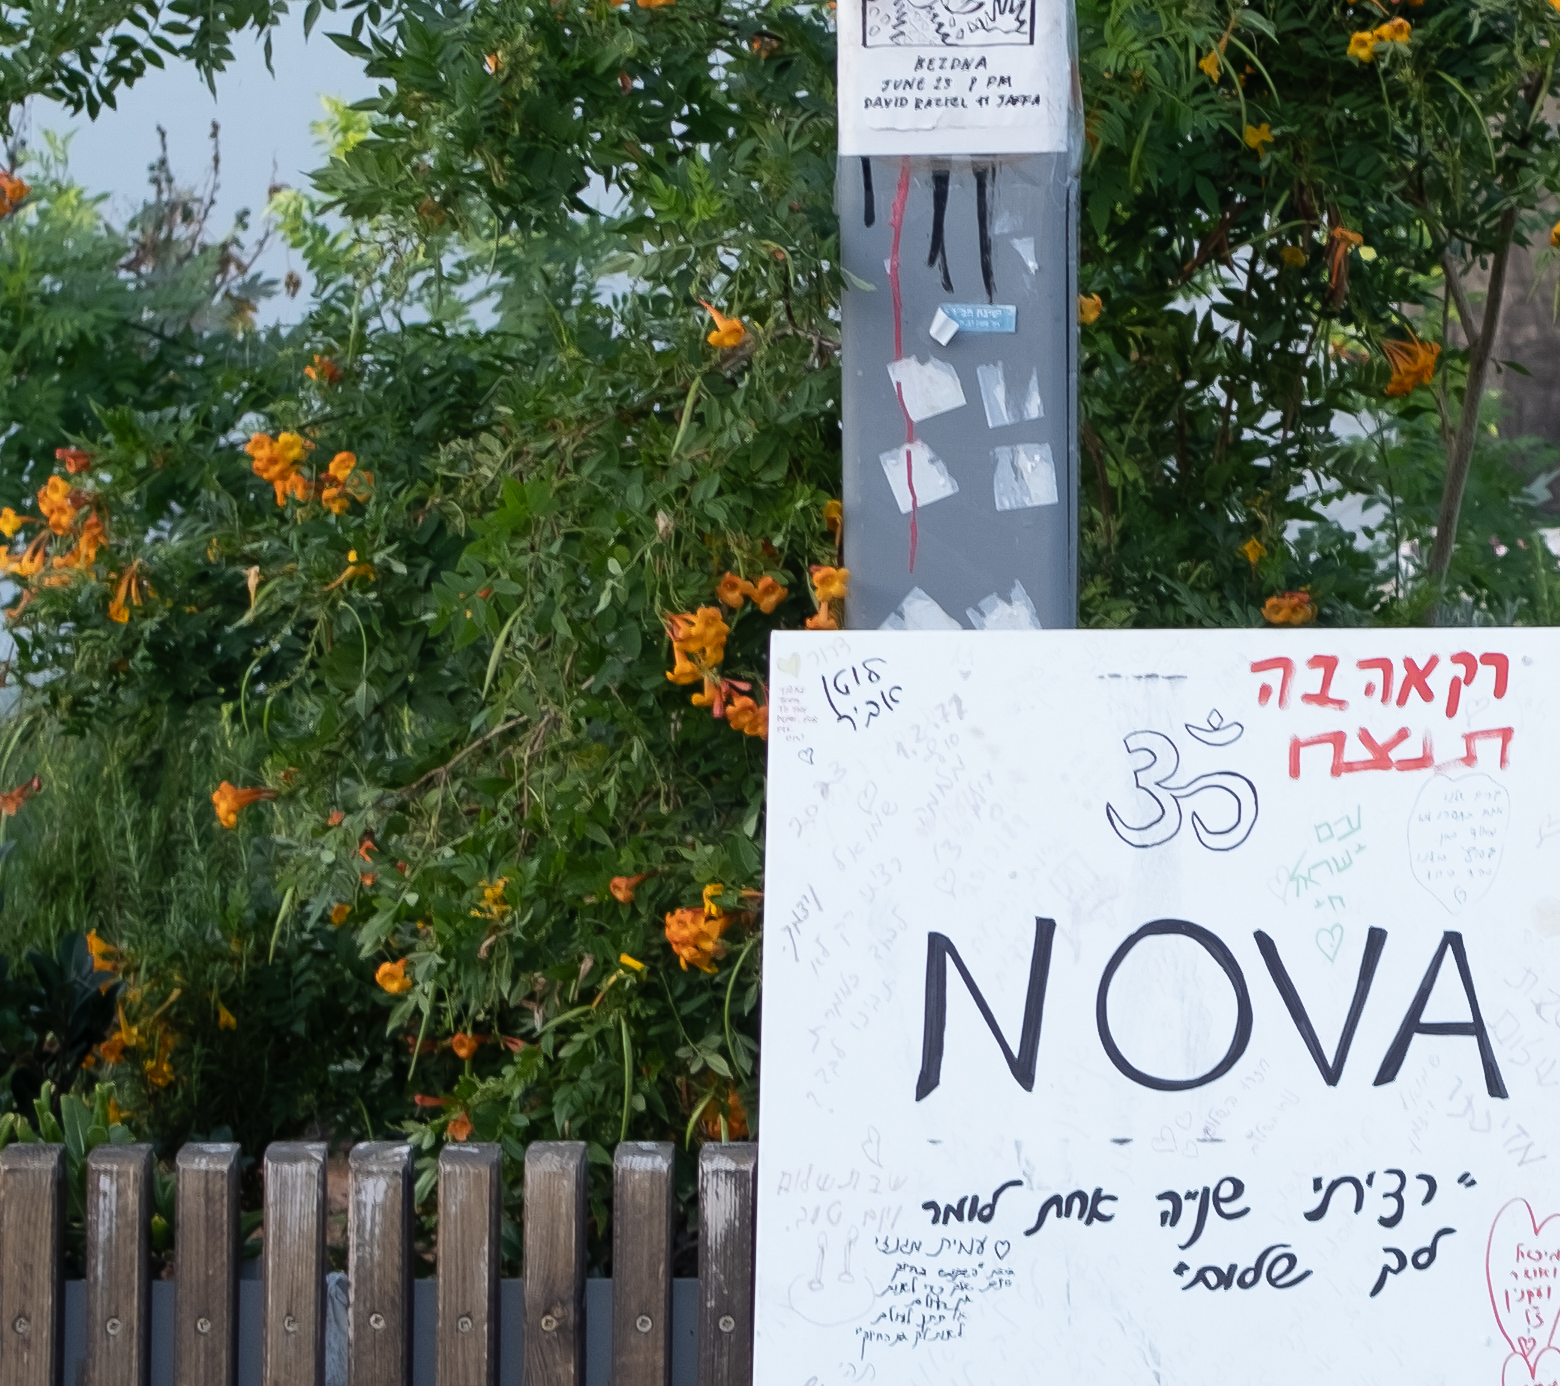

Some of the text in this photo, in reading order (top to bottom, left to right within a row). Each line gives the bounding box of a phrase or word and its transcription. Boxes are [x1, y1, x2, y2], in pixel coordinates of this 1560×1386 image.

[863, 96, 909, 110] DAVID
[1250, 653, 1441, 711] אהבה
[1288, 725, 1516, 780] תנצח
[915, 916, 1510, 1103] NOVA
[921, 1179, 1023, 1226] לומר
[1024, 1187, 1118, 1238] אחת
